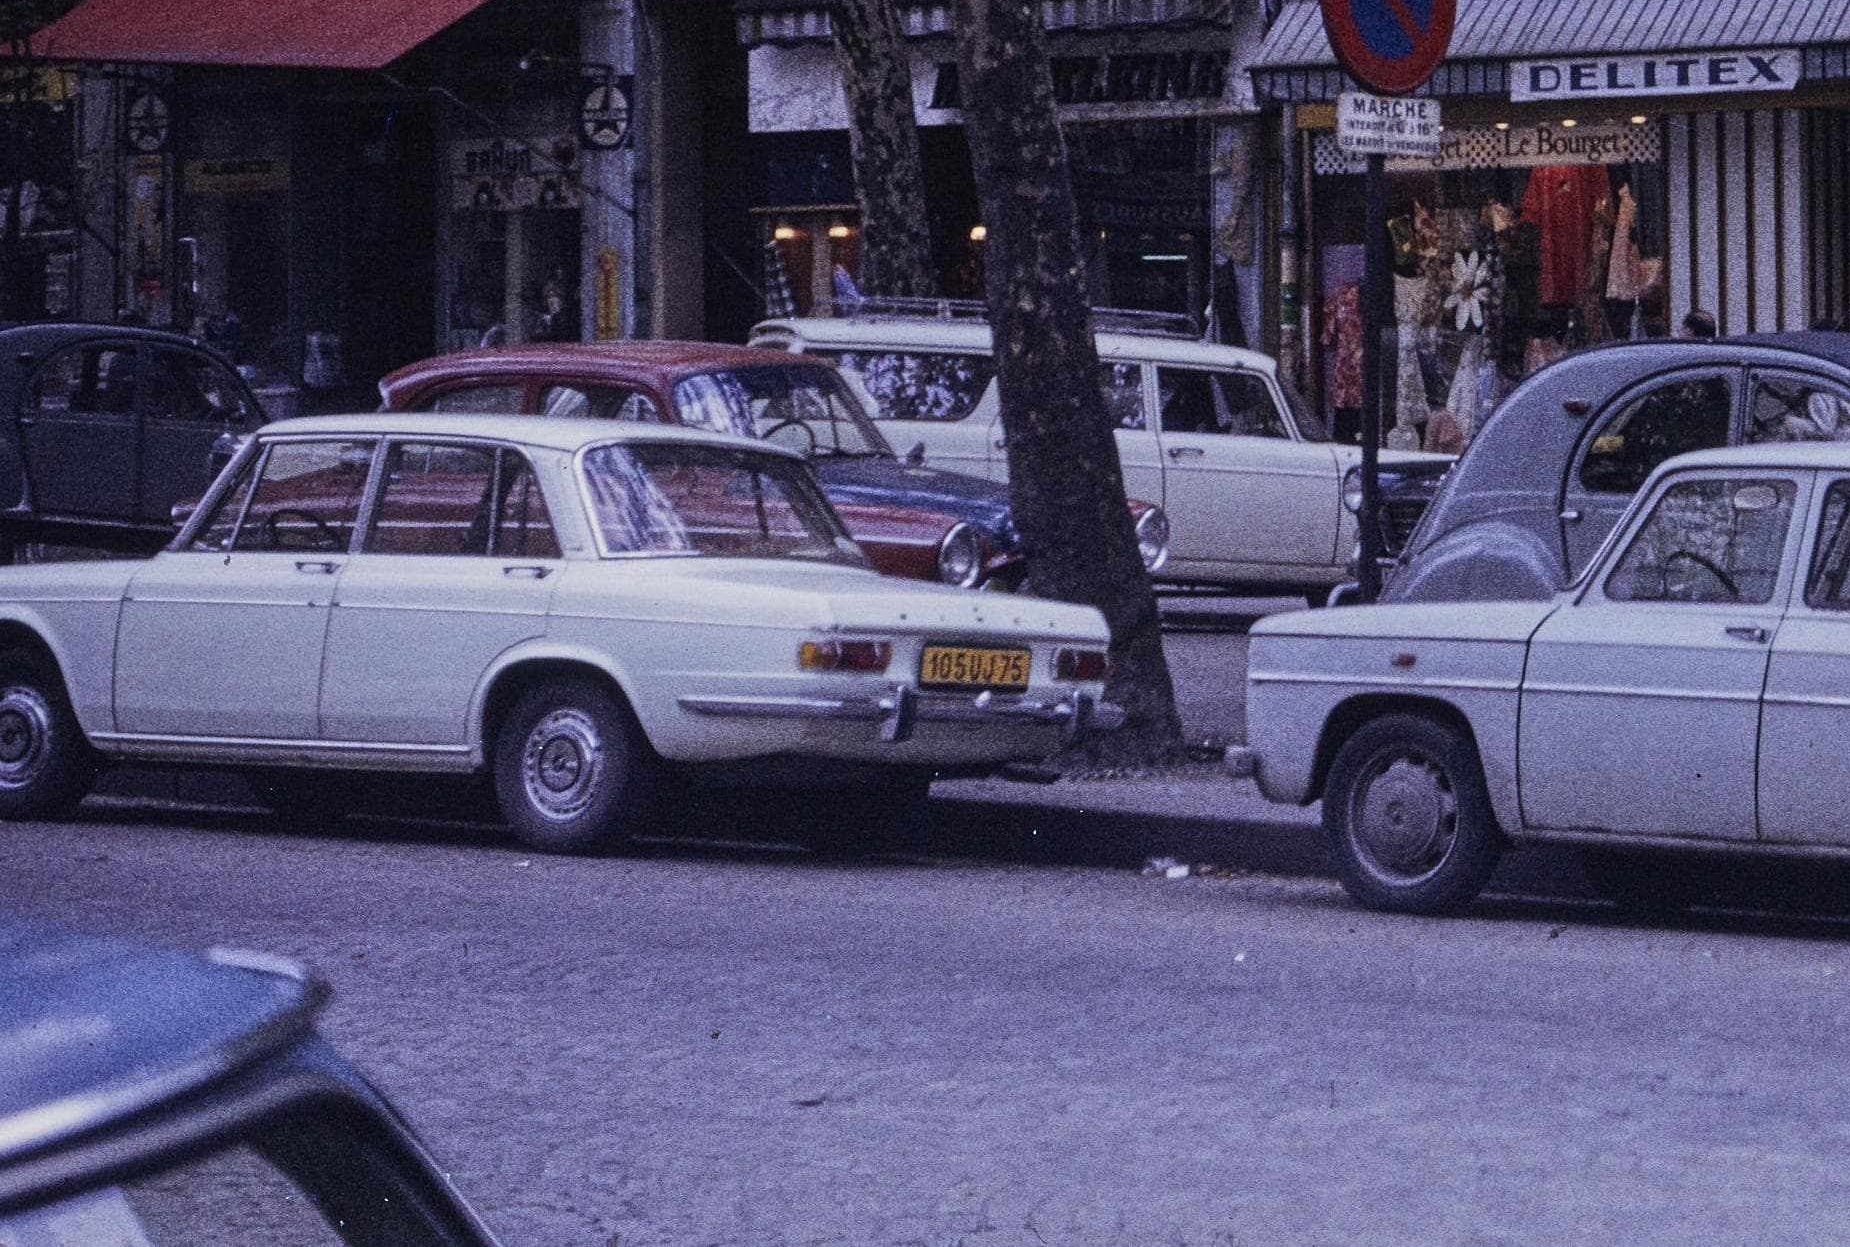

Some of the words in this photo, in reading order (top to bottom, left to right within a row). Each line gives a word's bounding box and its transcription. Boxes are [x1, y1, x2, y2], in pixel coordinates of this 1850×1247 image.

[1529, 55, 1782, 92] DELITEX
[1505, 129, 1531, 157] Le
[1537, 125, 1620, 163] Bourget
